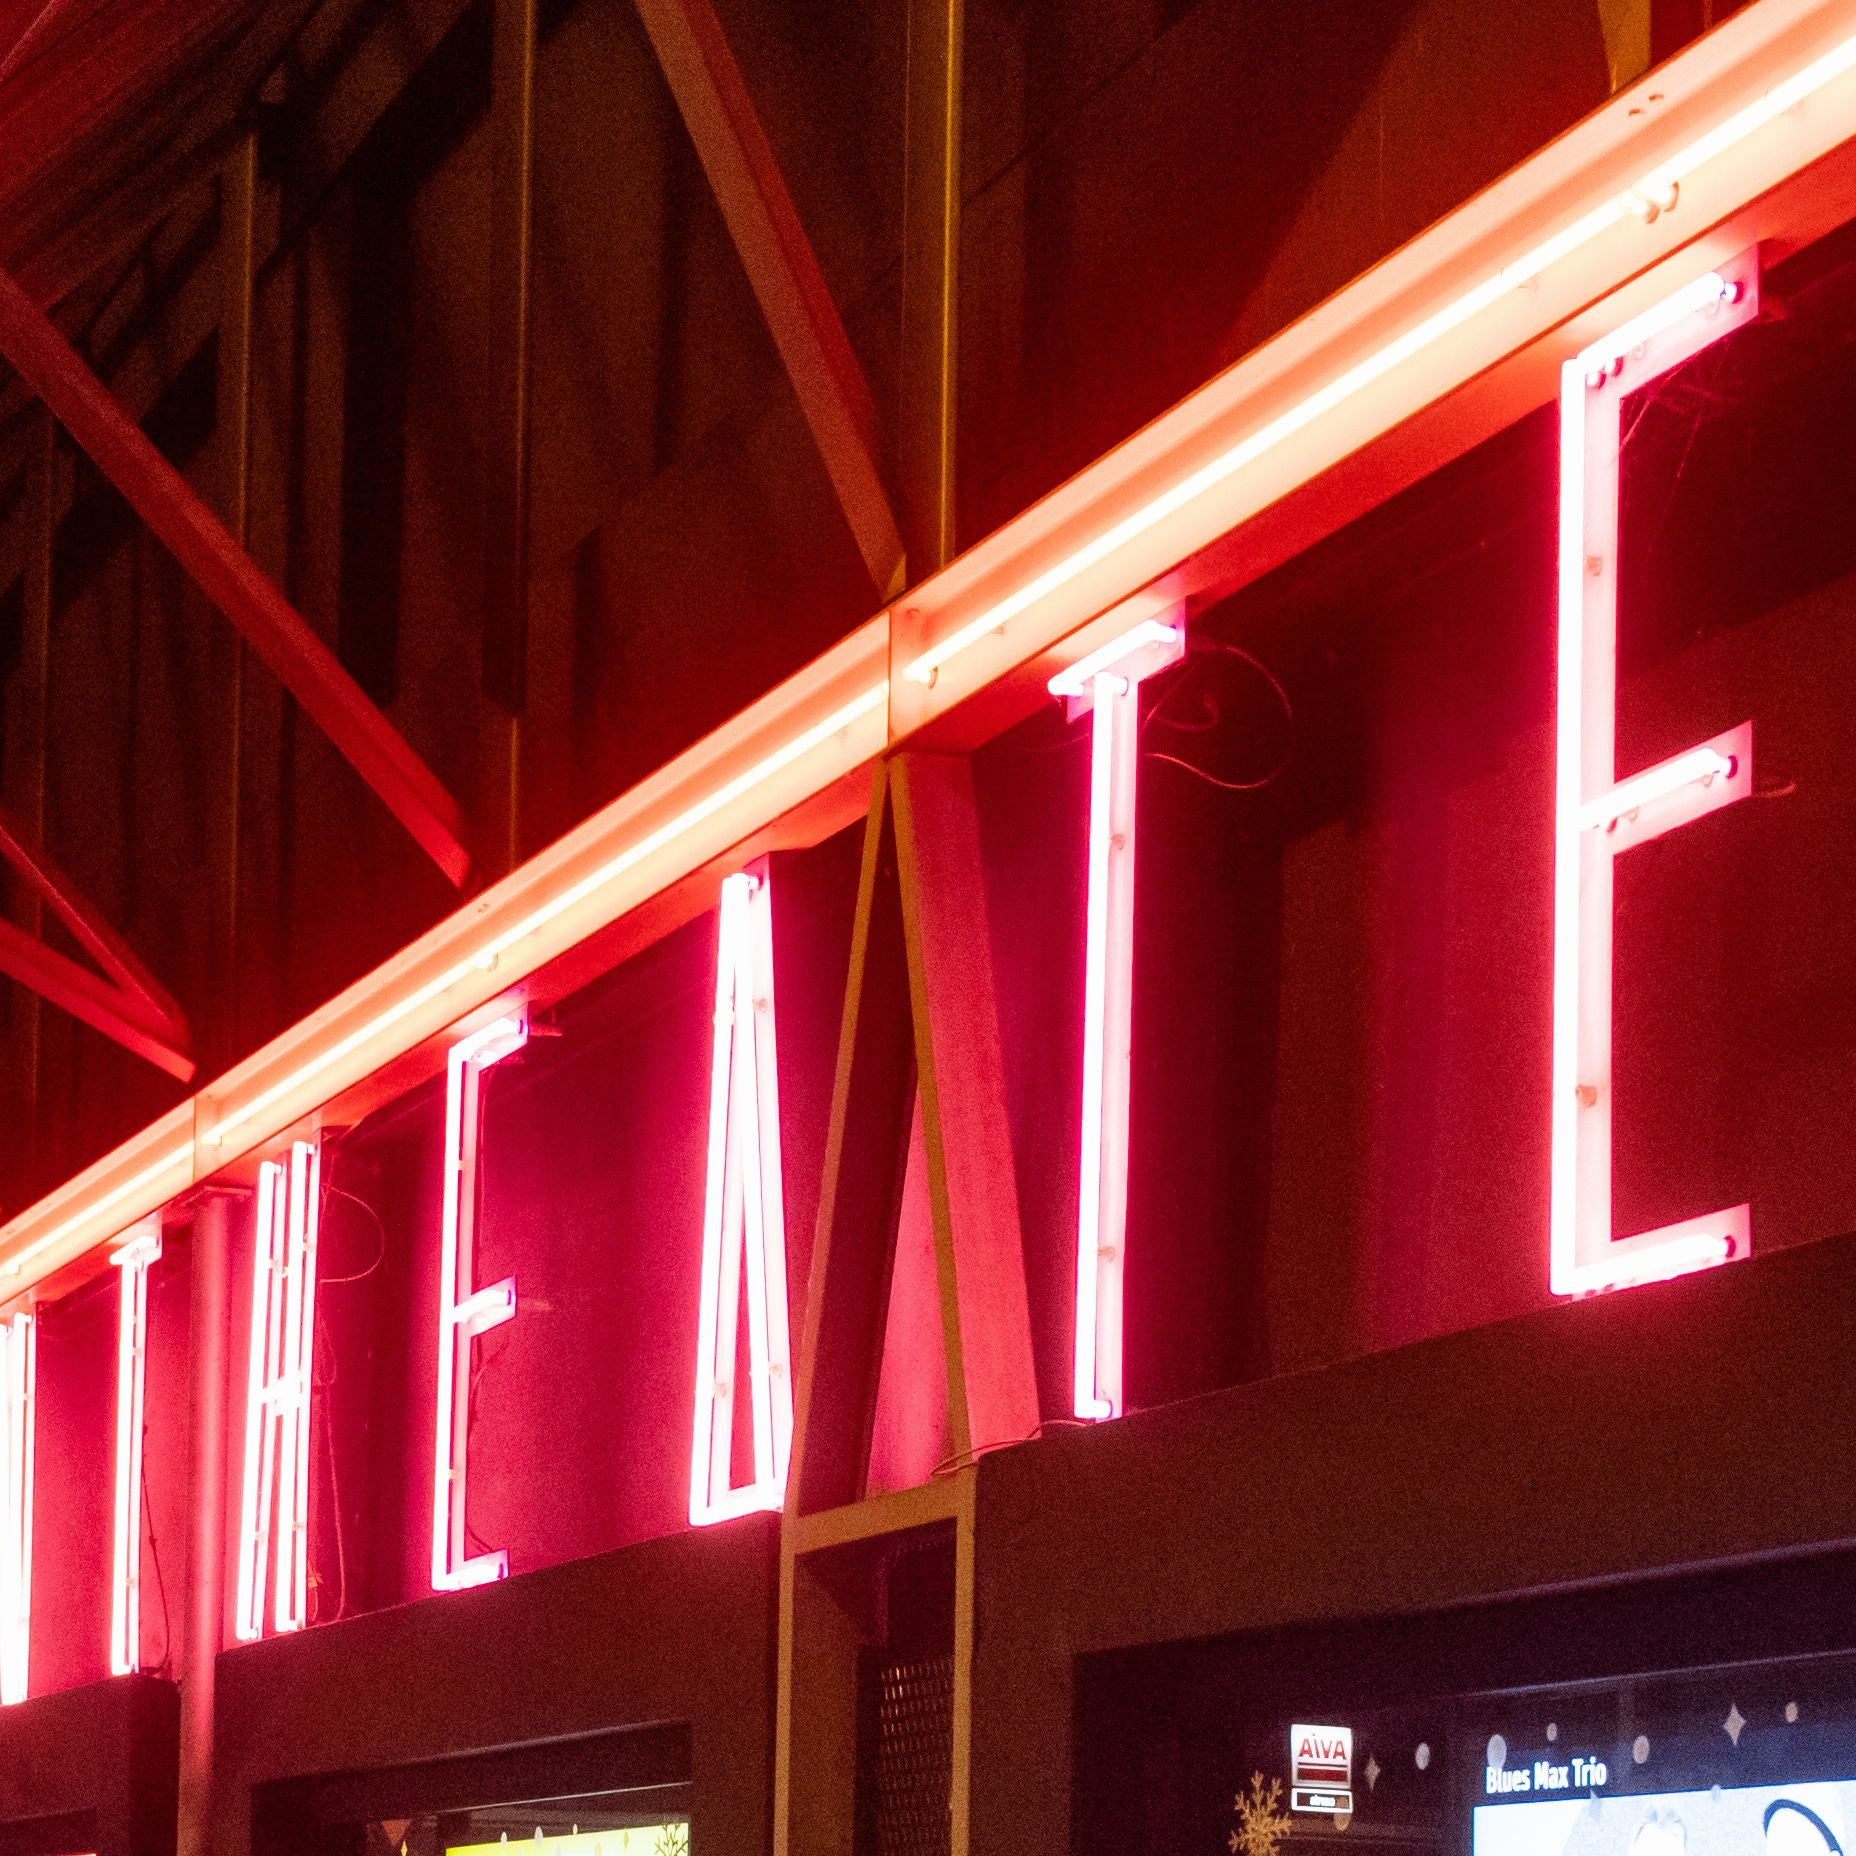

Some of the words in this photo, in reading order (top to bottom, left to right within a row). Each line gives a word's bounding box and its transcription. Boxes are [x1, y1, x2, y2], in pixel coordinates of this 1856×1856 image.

[1485, 1767, 1531, 1794] Blues
[1534, 1761, 1569, 1790] Max
[1573, 1756, 1608, 1787] Trio
